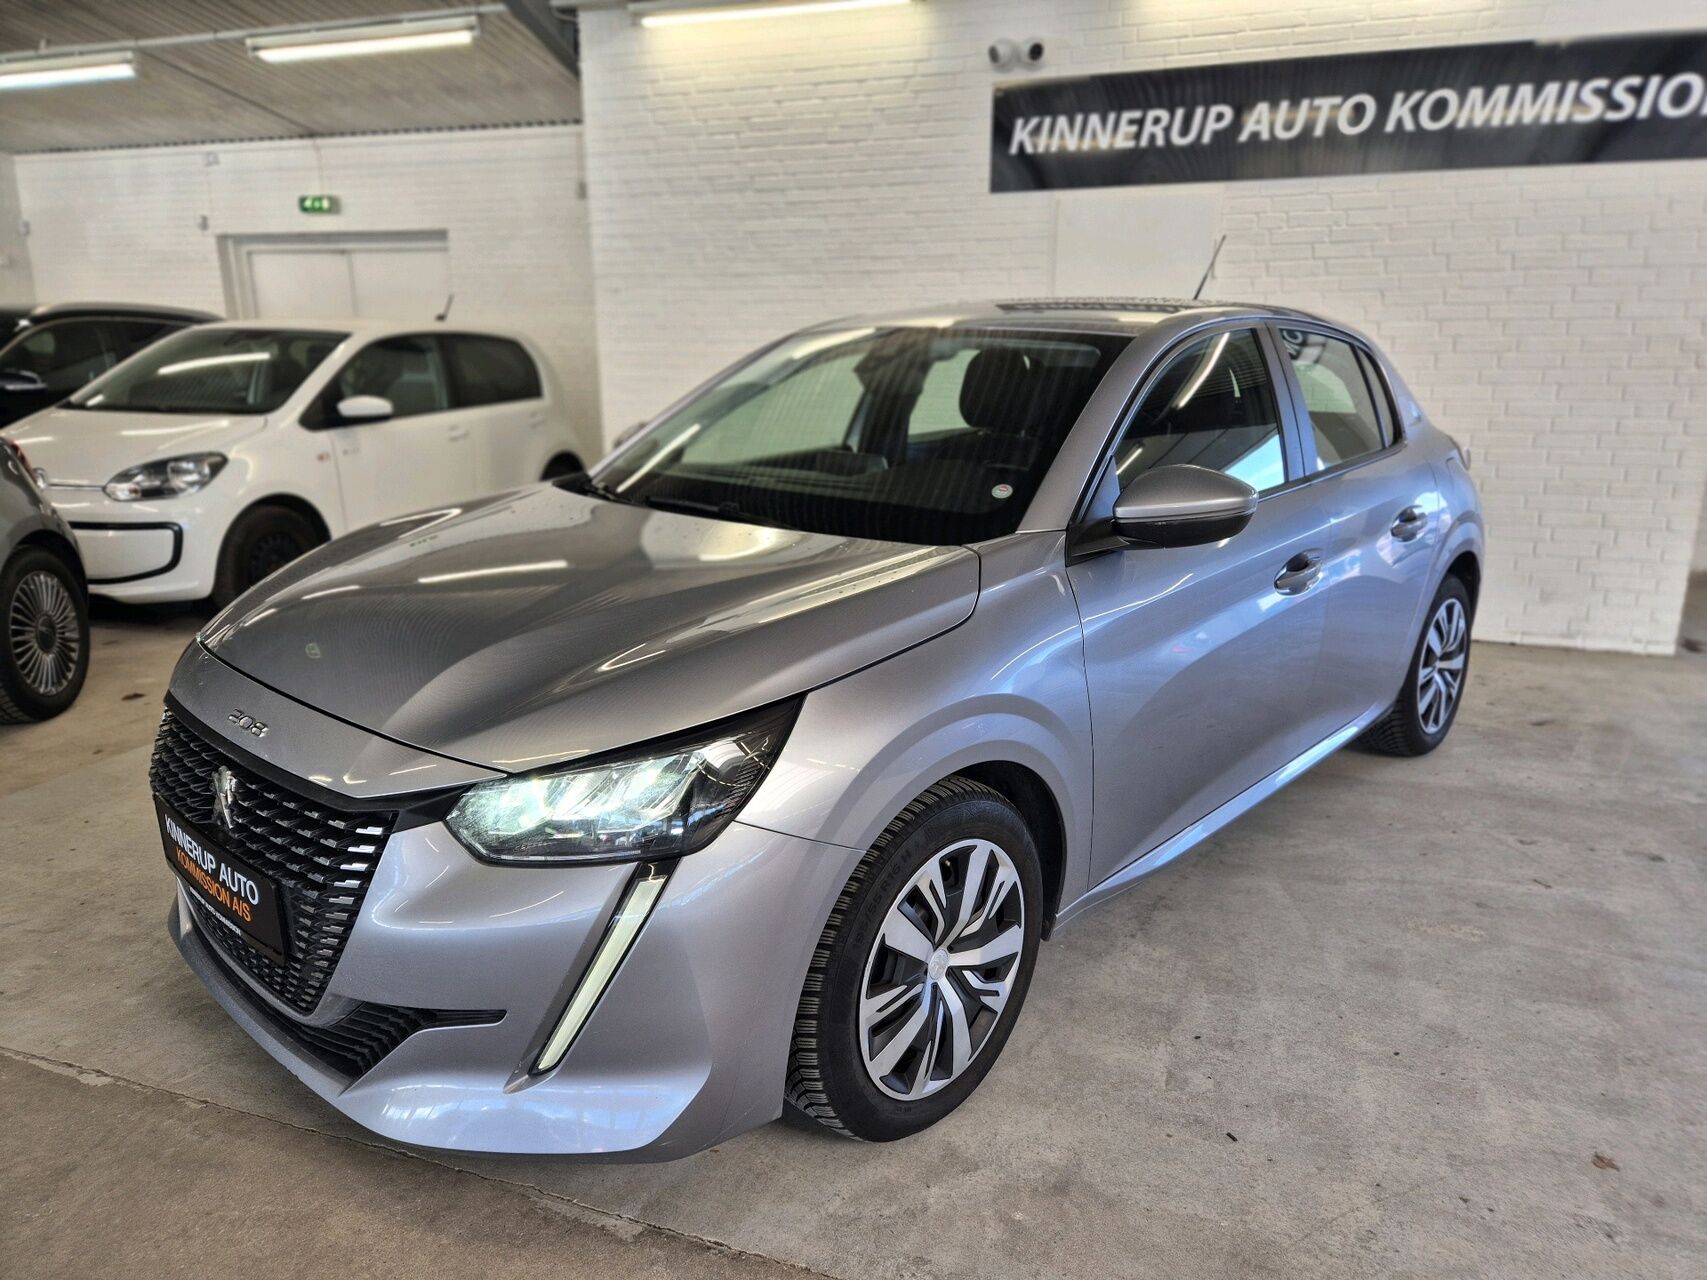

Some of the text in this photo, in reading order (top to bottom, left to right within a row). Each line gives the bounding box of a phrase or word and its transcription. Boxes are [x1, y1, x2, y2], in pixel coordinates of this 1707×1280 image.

[1008, 71, 1707, 155] KINNERUP AUTO KOMMISSIO
[228, 708, 270, 738] 208
[164, 813, 259, 906] KINNERUP AUTO
[176, 845, 231, 908] KOMMISSION
